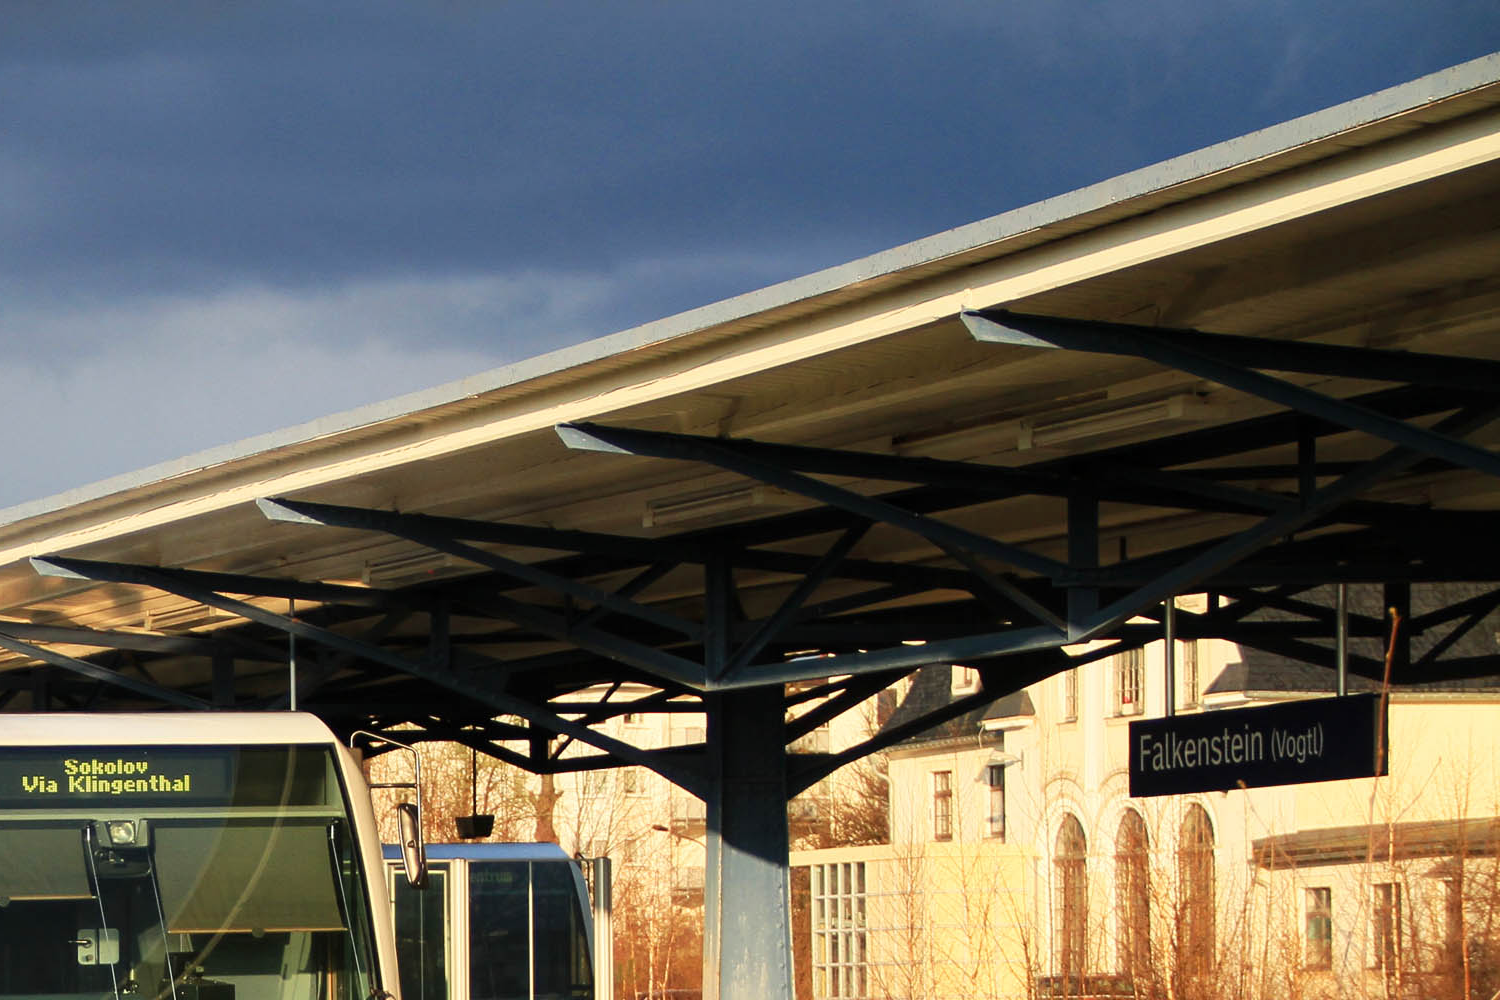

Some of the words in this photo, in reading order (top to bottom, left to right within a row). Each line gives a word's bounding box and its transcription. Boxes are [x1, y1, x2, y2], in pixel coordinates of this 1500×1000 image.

[1140, 724, 1263, 772] Falkenstein
[1271, 722, 1324, 763] (Vogtl)
[64, 759, 148, 775] Sokolov
[22, 776, 58, 793] Via
[68, 775, 190, 794] Klingenthal
